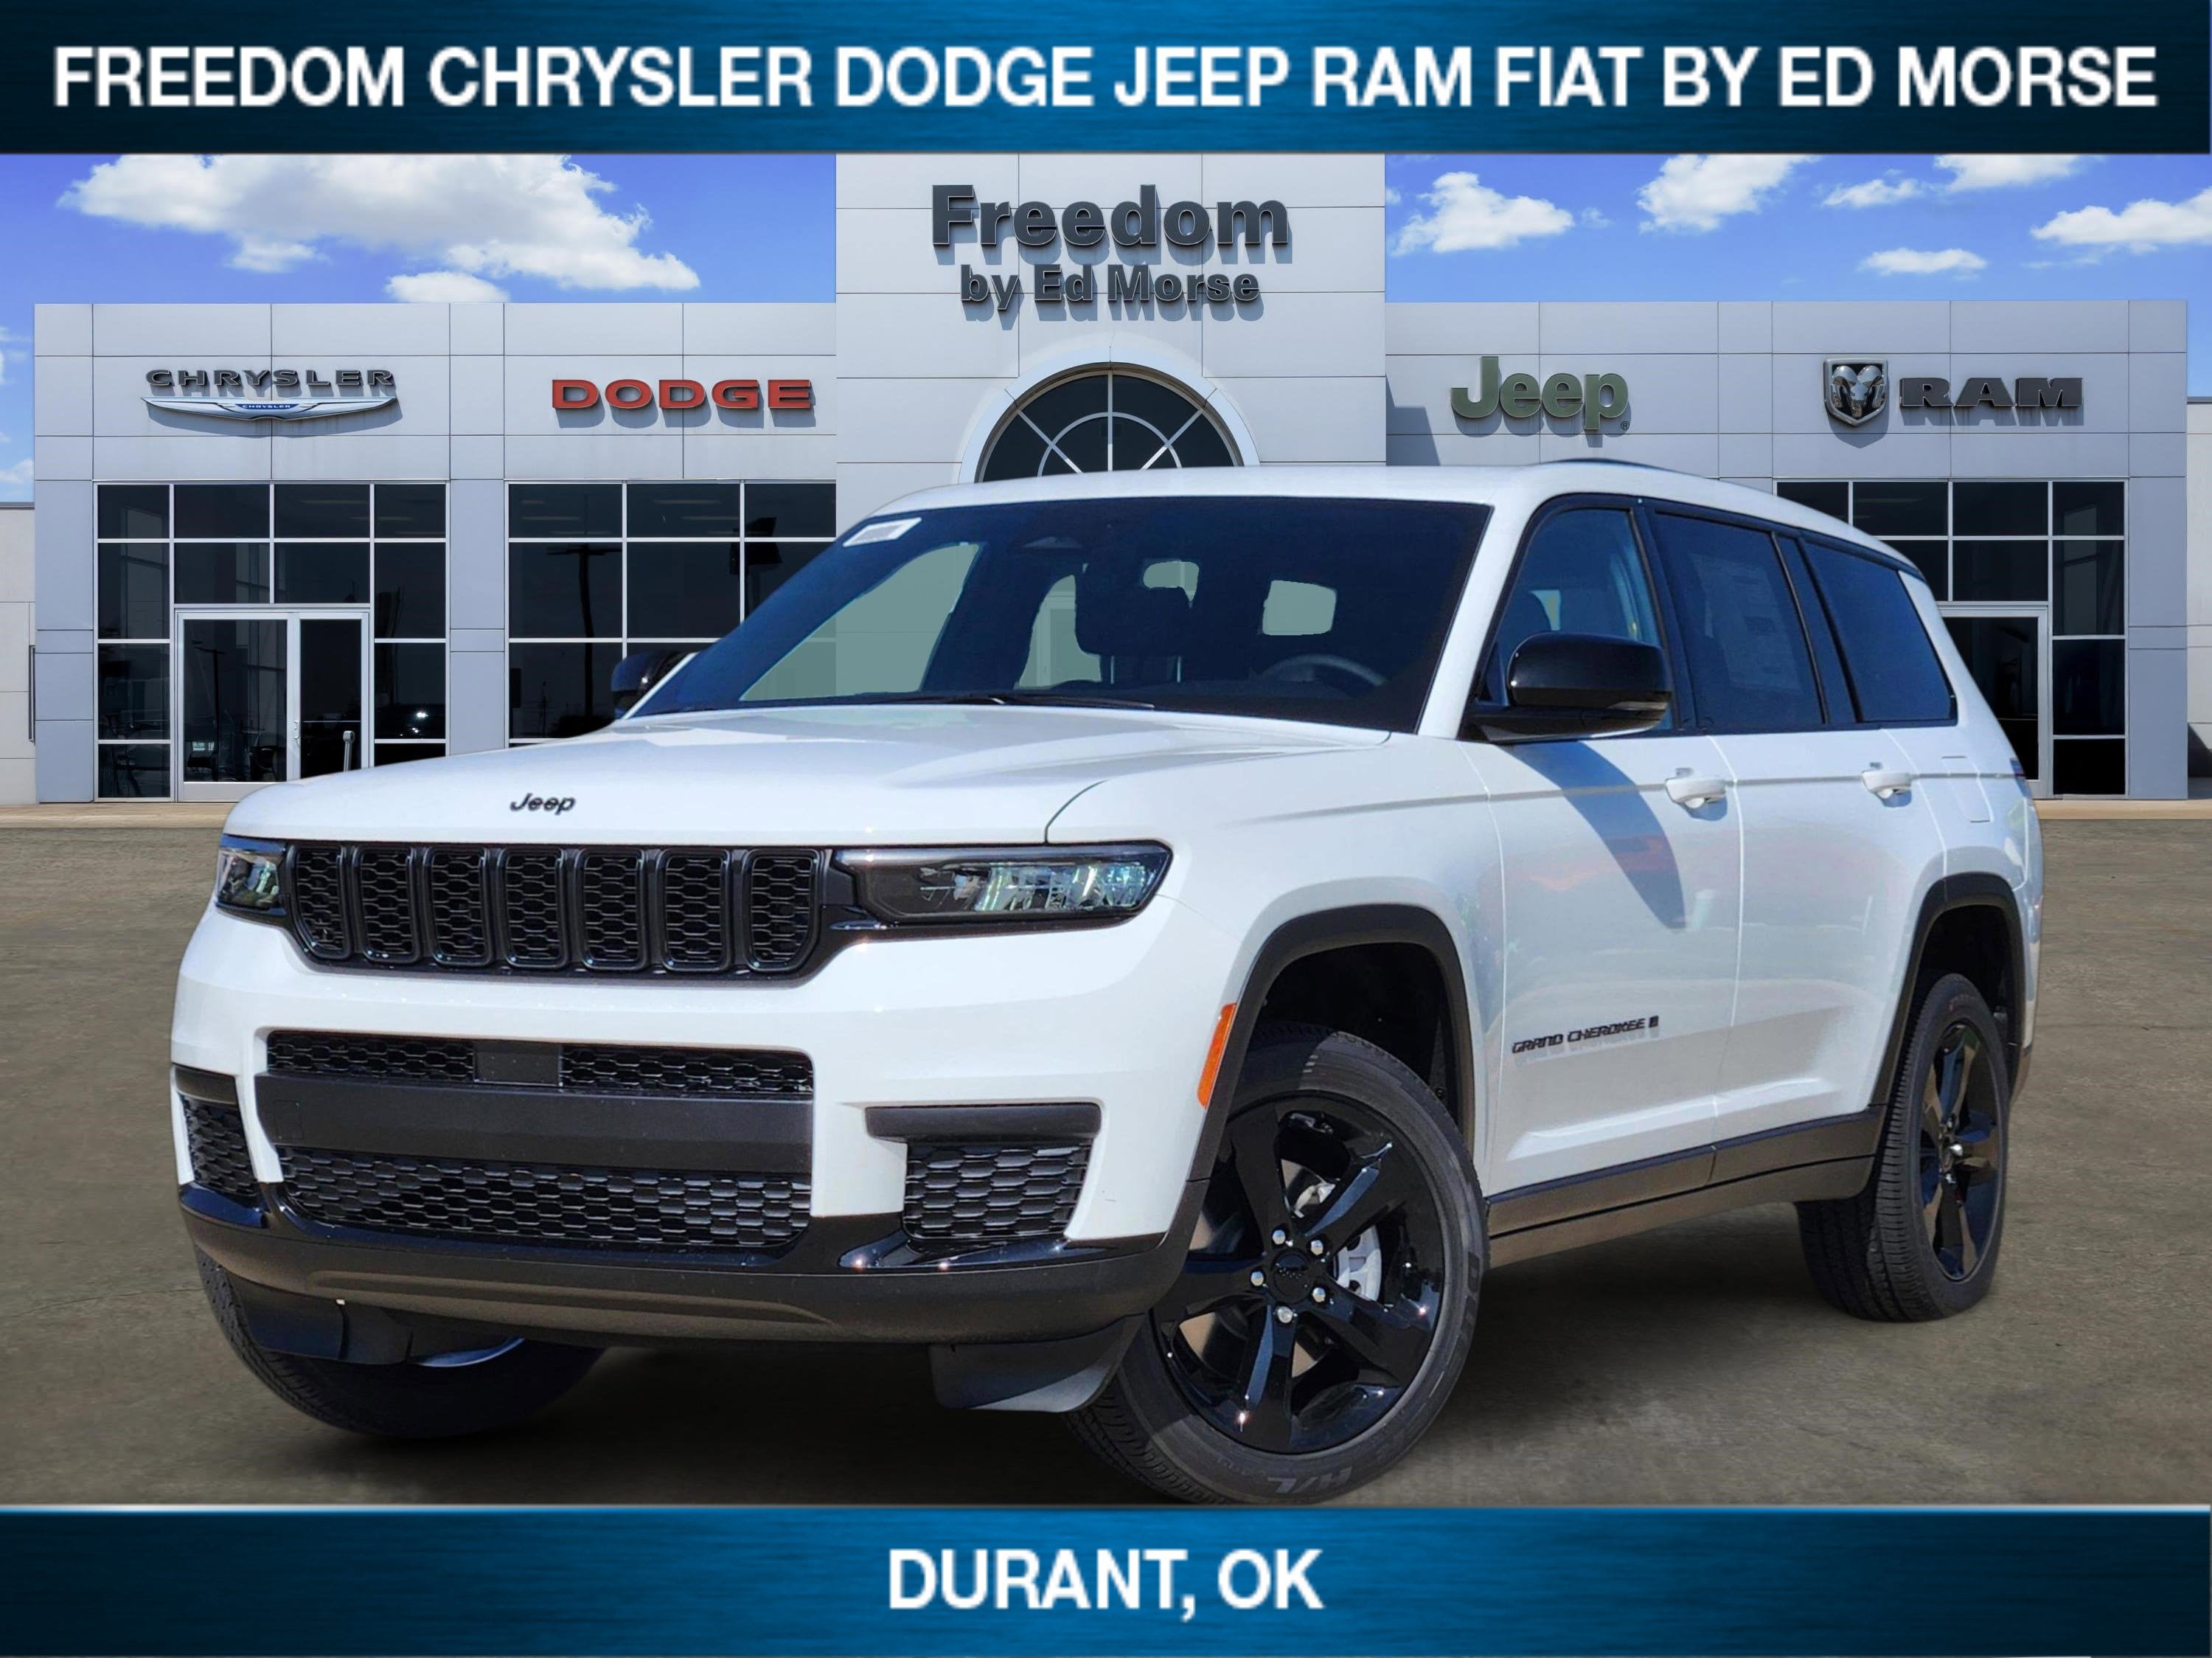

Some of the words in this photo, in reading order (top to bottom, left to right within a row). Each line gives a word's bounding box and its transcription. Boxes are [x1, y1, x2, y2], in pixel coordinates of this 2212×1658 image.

[932, 184, 1289, 246] Freedom
[960, 264, 1020, 311] by
[1034, 264, 1094, 302] Ed
[1107, 264, 1260, 302] Morse
[145, 369, 395, 387] CHRYSLER
[552, 379, 813, 409] DODGE
[1450, 355, 1629, 431] Jeep
[1899, 378, 2084, 408] RAM
[509, 793, 577, 816] Jeep
[1512, 1033, 1564, 1054] GRAND
[1567, 1018, 1646, 1042] CHEROKEE
